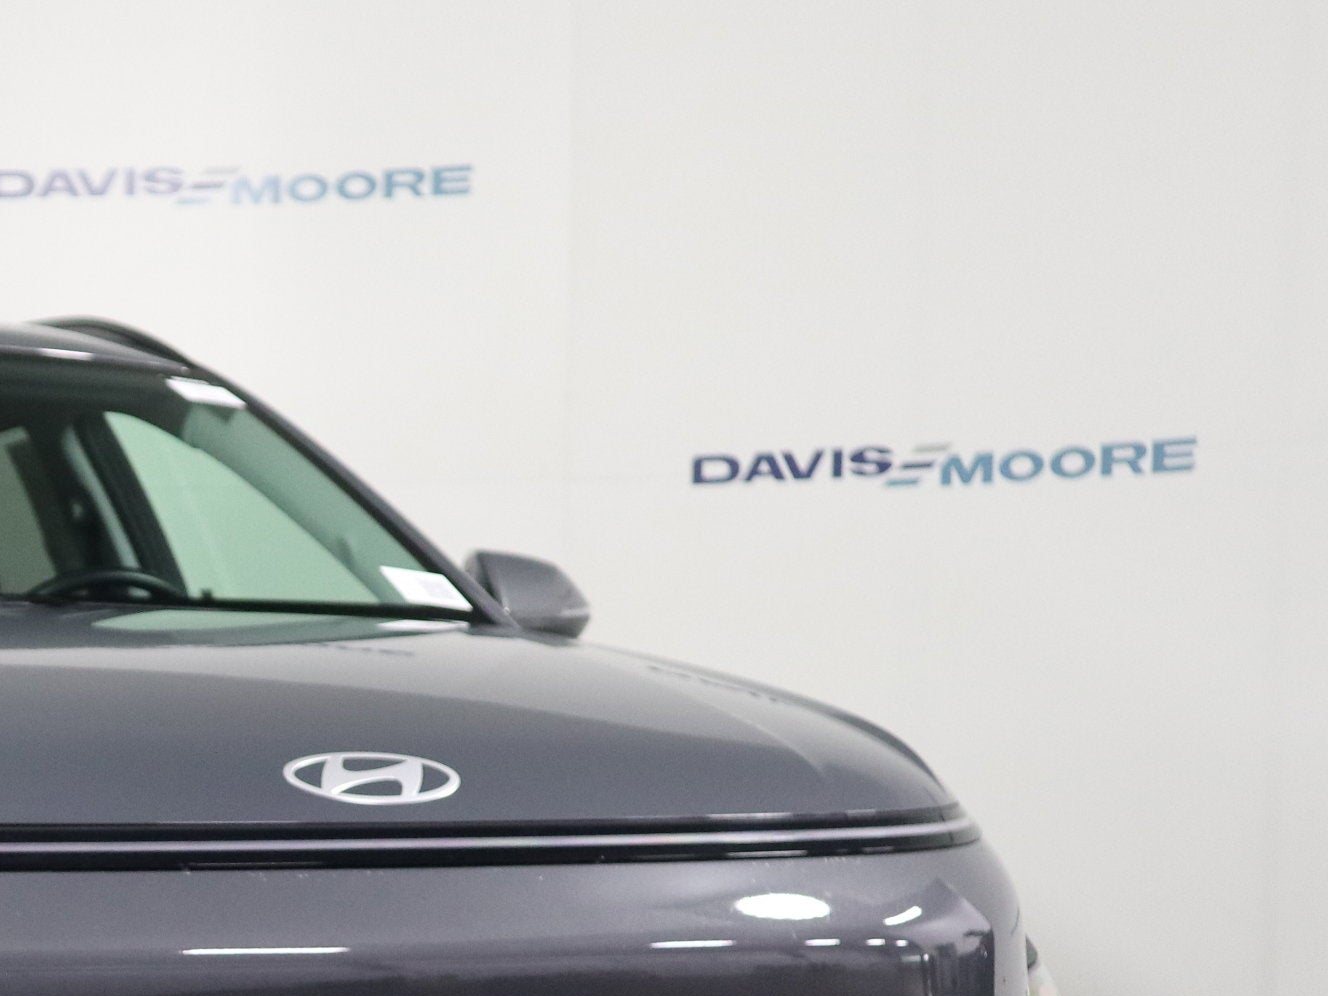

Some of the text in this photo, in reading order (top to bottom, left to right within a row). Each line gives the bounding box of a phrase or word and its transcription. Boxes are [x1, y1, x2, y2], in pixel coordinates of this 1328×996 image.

[229, 164, 474, 204] MOORE
[691, 436, 1197, 486] DAVIS MOORE
